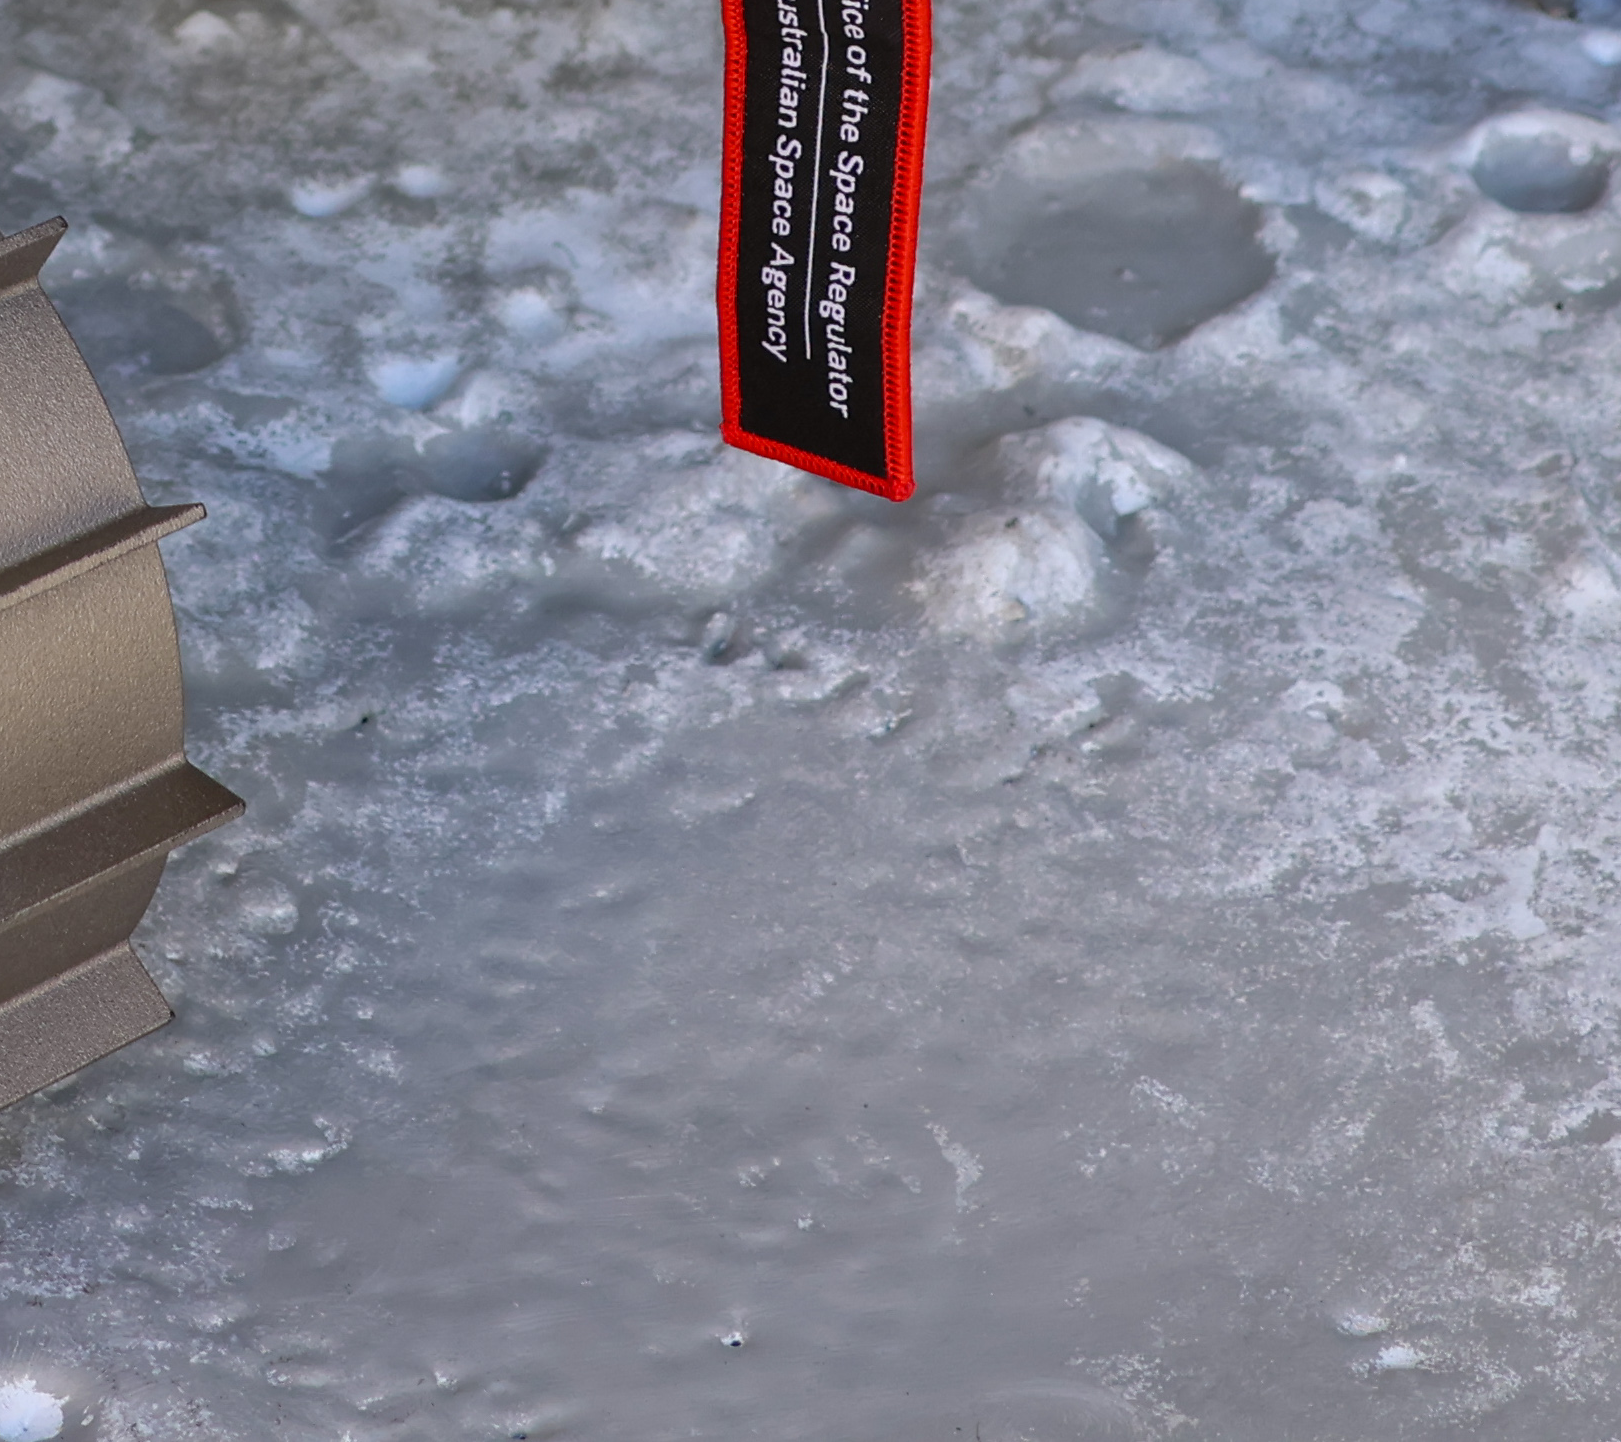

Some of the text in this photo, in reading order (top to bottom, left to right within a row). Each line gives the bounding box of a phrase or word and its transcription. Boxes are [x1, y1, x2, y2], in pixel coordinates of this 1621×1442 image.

[847, 46, 871, 82] of
[840, 90, 869, 142] the
[769, 135, 801, 235] Space
[830, 151, 863, 251] Space
[762, 243, 794, 362] Agency
[819, 262, 855, 418] Regulator
